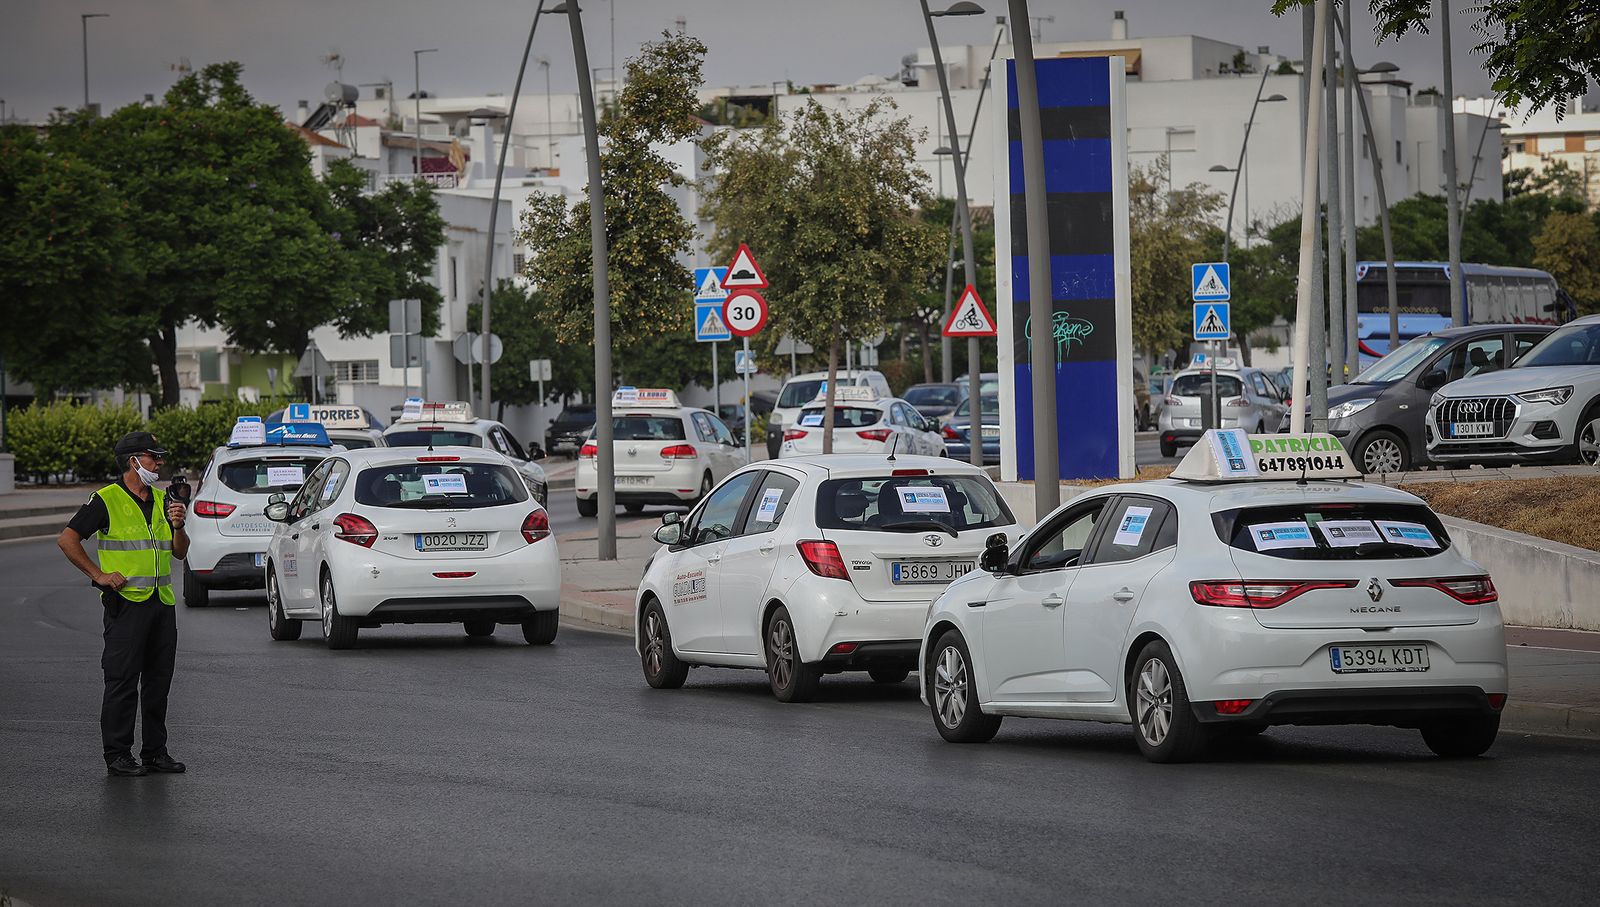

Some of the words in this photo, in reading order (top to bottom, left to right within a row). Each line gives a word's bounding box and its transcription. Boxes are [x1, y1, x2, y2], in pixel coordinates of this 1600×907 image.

[733, 306, 755, 321] 30
[294, 406, 304, 418] L
[312, 409, 360, 421] TORRES
[1456, 424, 1474, 434] 1301
[1249, 437, 1344, 454] PATRICIA
[1258, 455, 1344, 472] 647881044
[424, 535, 457, 546] 0020
[461, 534, 485, 546] JZZ
[901, 564, 938, 579] 5869
[1343, 649, 1387, 666] 5394
[1392, 648, 1423, 665] KDT
